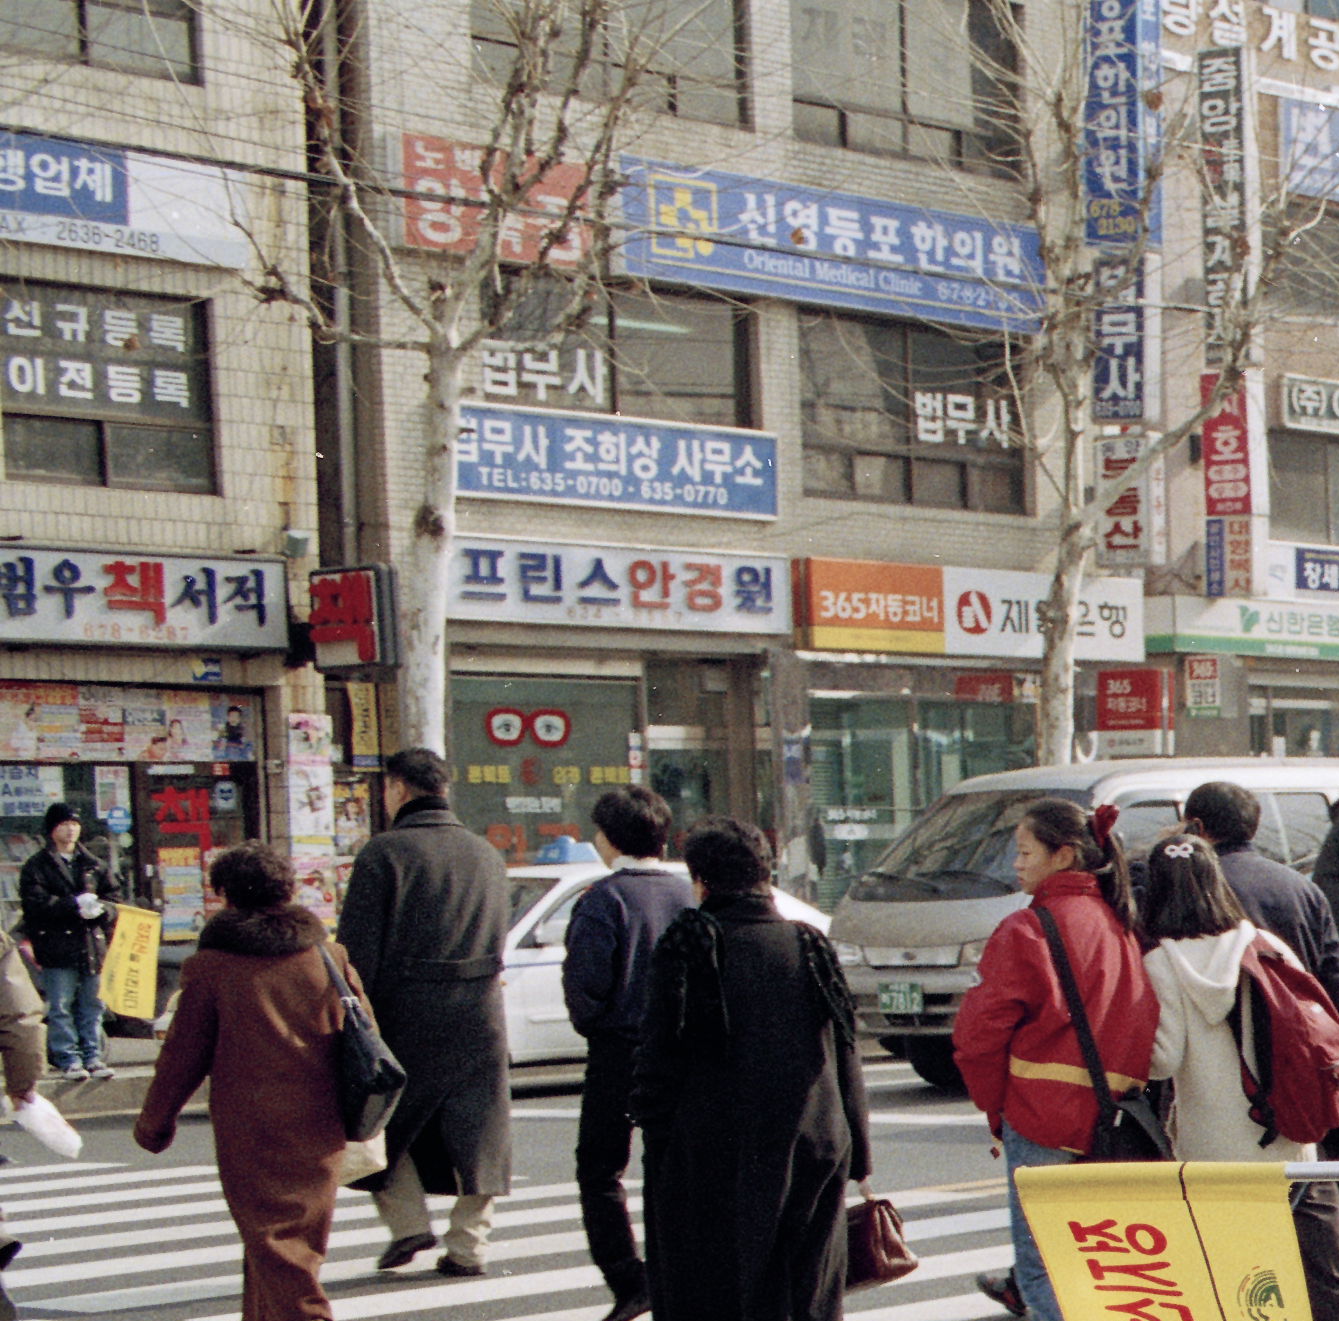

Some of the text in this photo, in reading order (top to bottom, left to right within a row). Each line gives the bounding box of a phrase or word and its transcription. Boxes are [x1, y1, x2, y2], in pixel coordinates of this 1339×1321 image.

[744, 251, 810, 279] Oriental
[815, 263, 875, 289] Medical
[879, 274, 922, 296] Clinic
[5, 302, 186, 352] 신규등록
[9, 356, 191, 407] 이전등록
[482, 349, 607, 404] 법무사
[915, 390, 1012, 448] 법무사
[456, 416, 764, 486] 법무사 조희상 사무소
[460, 548, 774, 616] 프린스안경원
[819, 590, 940, 624] 365자동코너
[309, 573, 377, 662] 책
[1107, 678, 1131, 694] 365
[151, 785, 213, 854] 책
